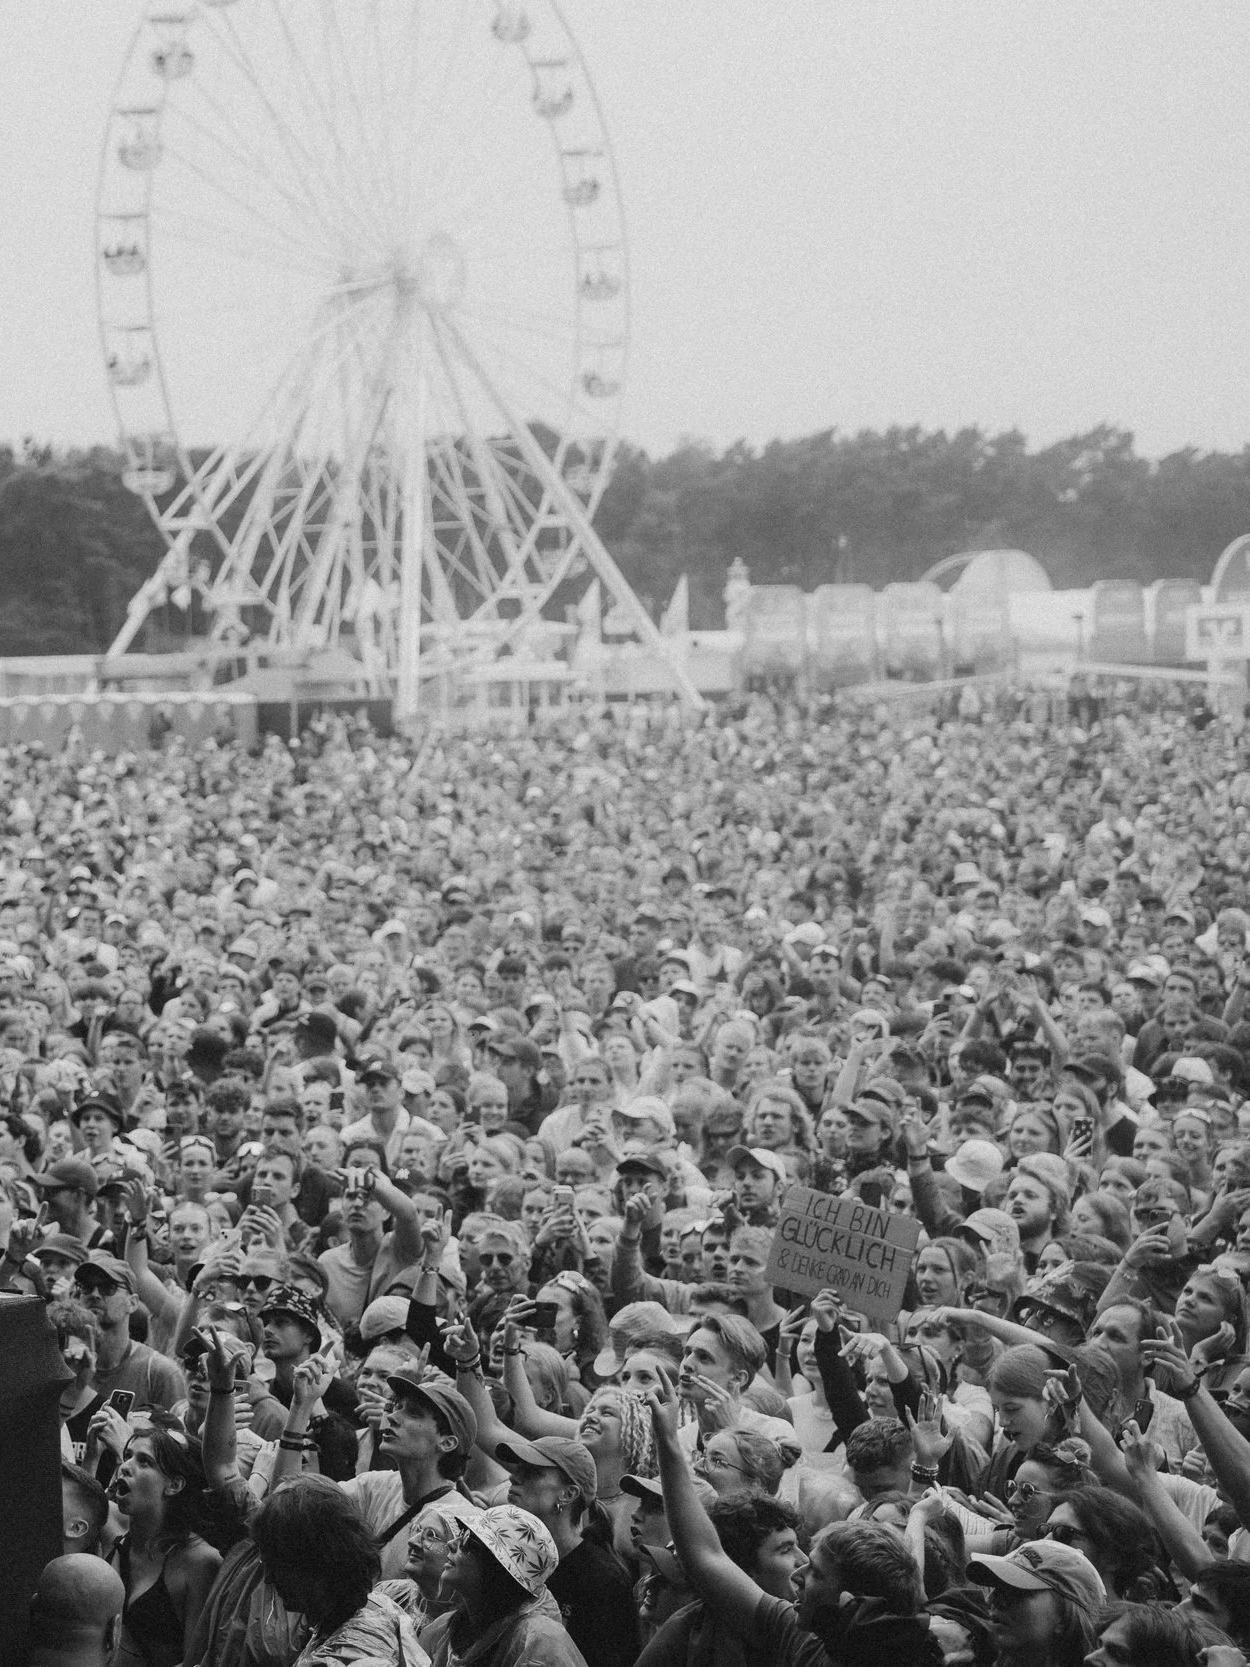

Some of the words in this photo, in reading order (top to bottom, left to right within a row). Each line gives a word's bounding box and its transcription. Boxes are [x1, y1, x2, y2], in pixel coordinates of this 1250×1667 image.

[805, 1194, 842, 1225] ICH
[849, 1206, 890, 1239] BIN
[781, 1216, 897, 1273] GLÜCKLICH
[777, 1248, 790, 1269] &
[791, 1252, 826, 1280] DENKE
[849, 1272, 865, 1293] AN
[866, 1276, 892, 1299] DICH
